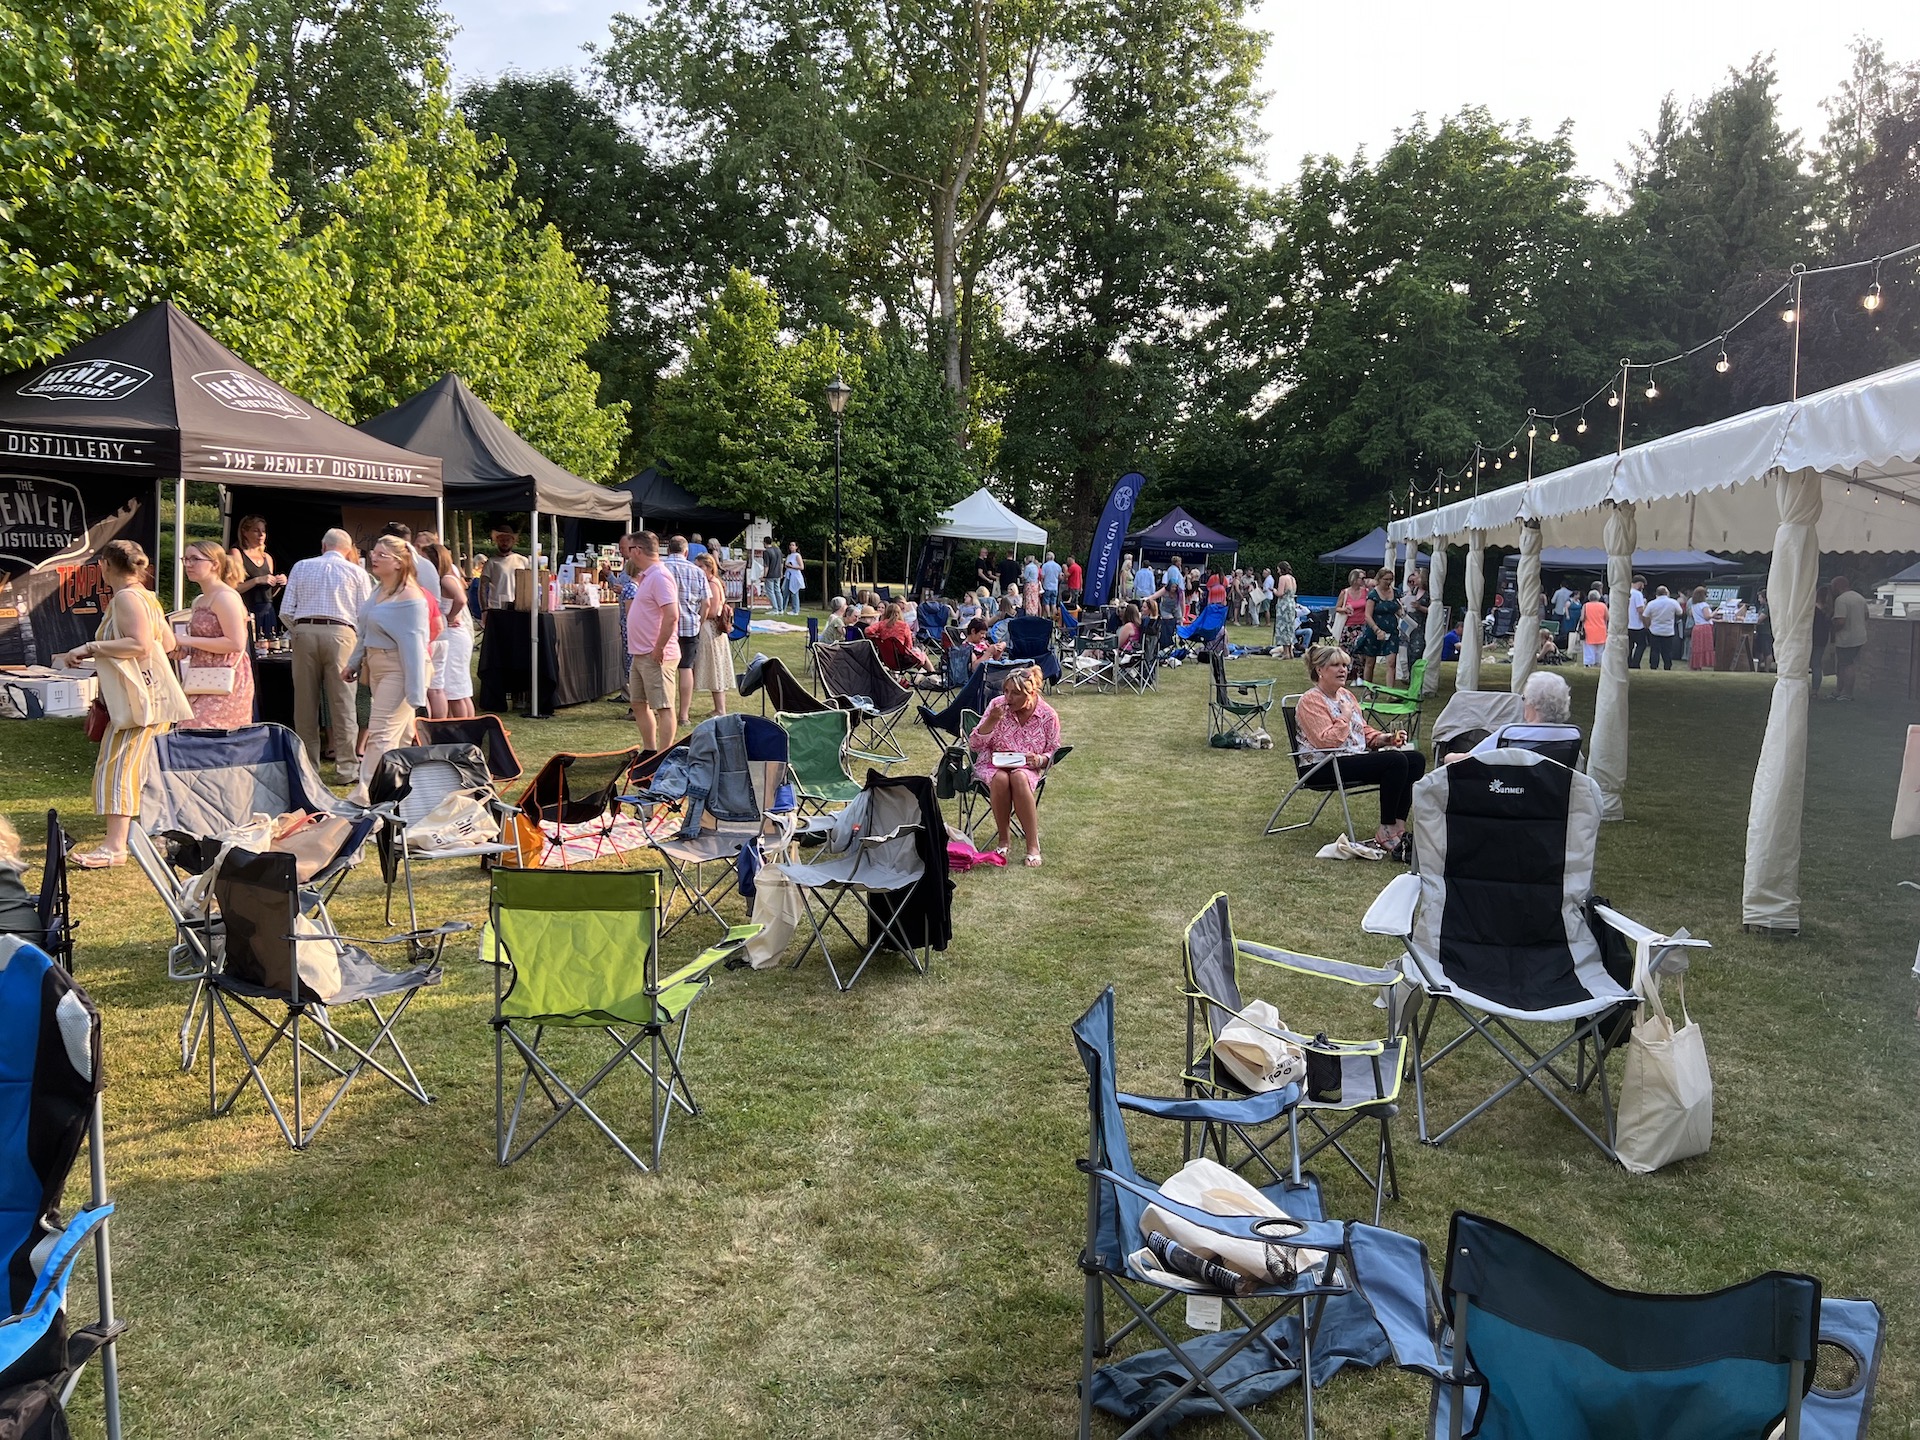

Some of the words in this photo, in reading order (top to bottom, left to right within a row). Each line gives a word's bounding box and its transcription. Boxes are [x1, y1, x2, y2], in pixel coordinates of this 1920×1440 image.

[91, 361, 110, 369] THE
[31, 384, 109, 397] DISTILLERY
[38, 367, 138, 391] HENLEY
[206, 379, 289, 407] HENLEY
[8, 434, 125, 460] DISTILLERY
[222, 452, 256, 470] THE
[263, 456, 326, 475] HENLEY
[332, 460, 413, 483] DISTILLERY
[16, 480, 35, 492] THE
[0, 492, 74, 531] ENLEY
[1106, 520, 1120, 541] GIN
